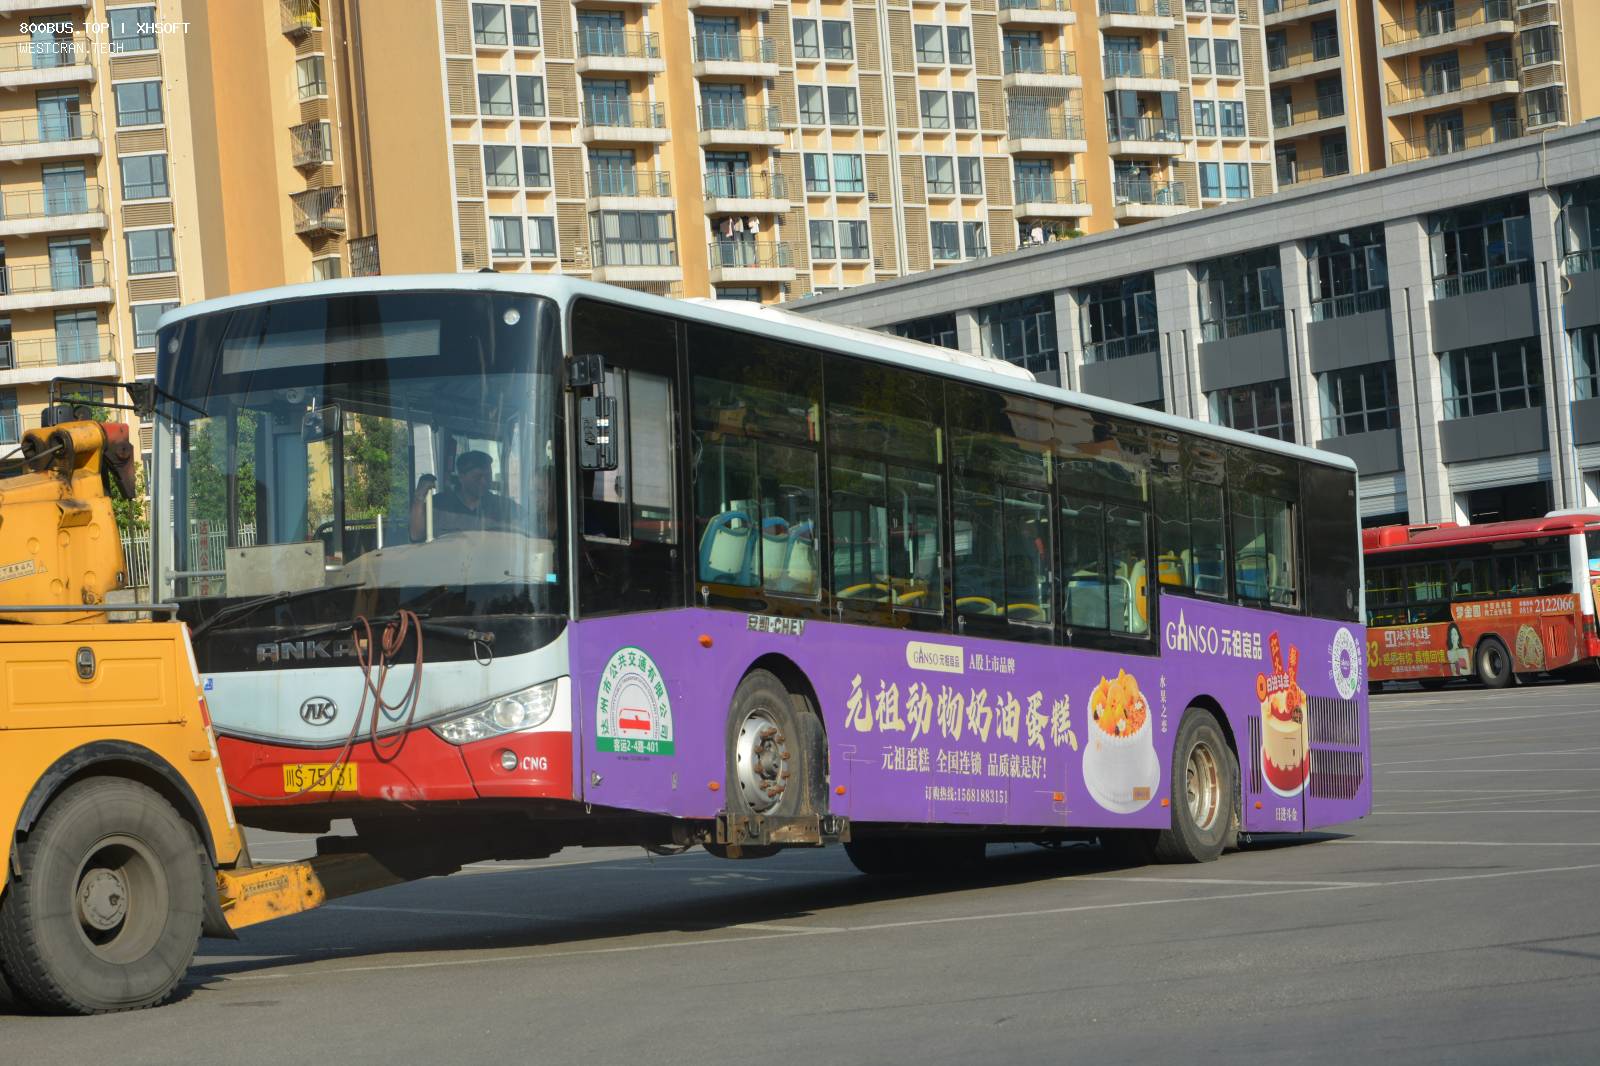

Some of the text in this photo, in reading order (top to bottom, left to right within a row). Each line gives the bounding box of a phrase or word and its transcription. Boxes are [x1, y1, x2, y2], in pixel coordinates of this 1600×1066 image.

[1535, 597, 1575, 613] 2122066
[1165, 607, 1219, 655] GANSO
[1221, 629, 1263, 660] 元祖食品
[913, 646, 939, 666] GANSO
[969, 653, 1016, 675] A股上市品牌
[844, 672, 1079, 751] 元祖动物奶油蛋糕
[523, 756, 548, 770] CNG
[881, 745, 930, 772] 元祖蛋糕
[936, 748, 982, 776] 全国连锁
